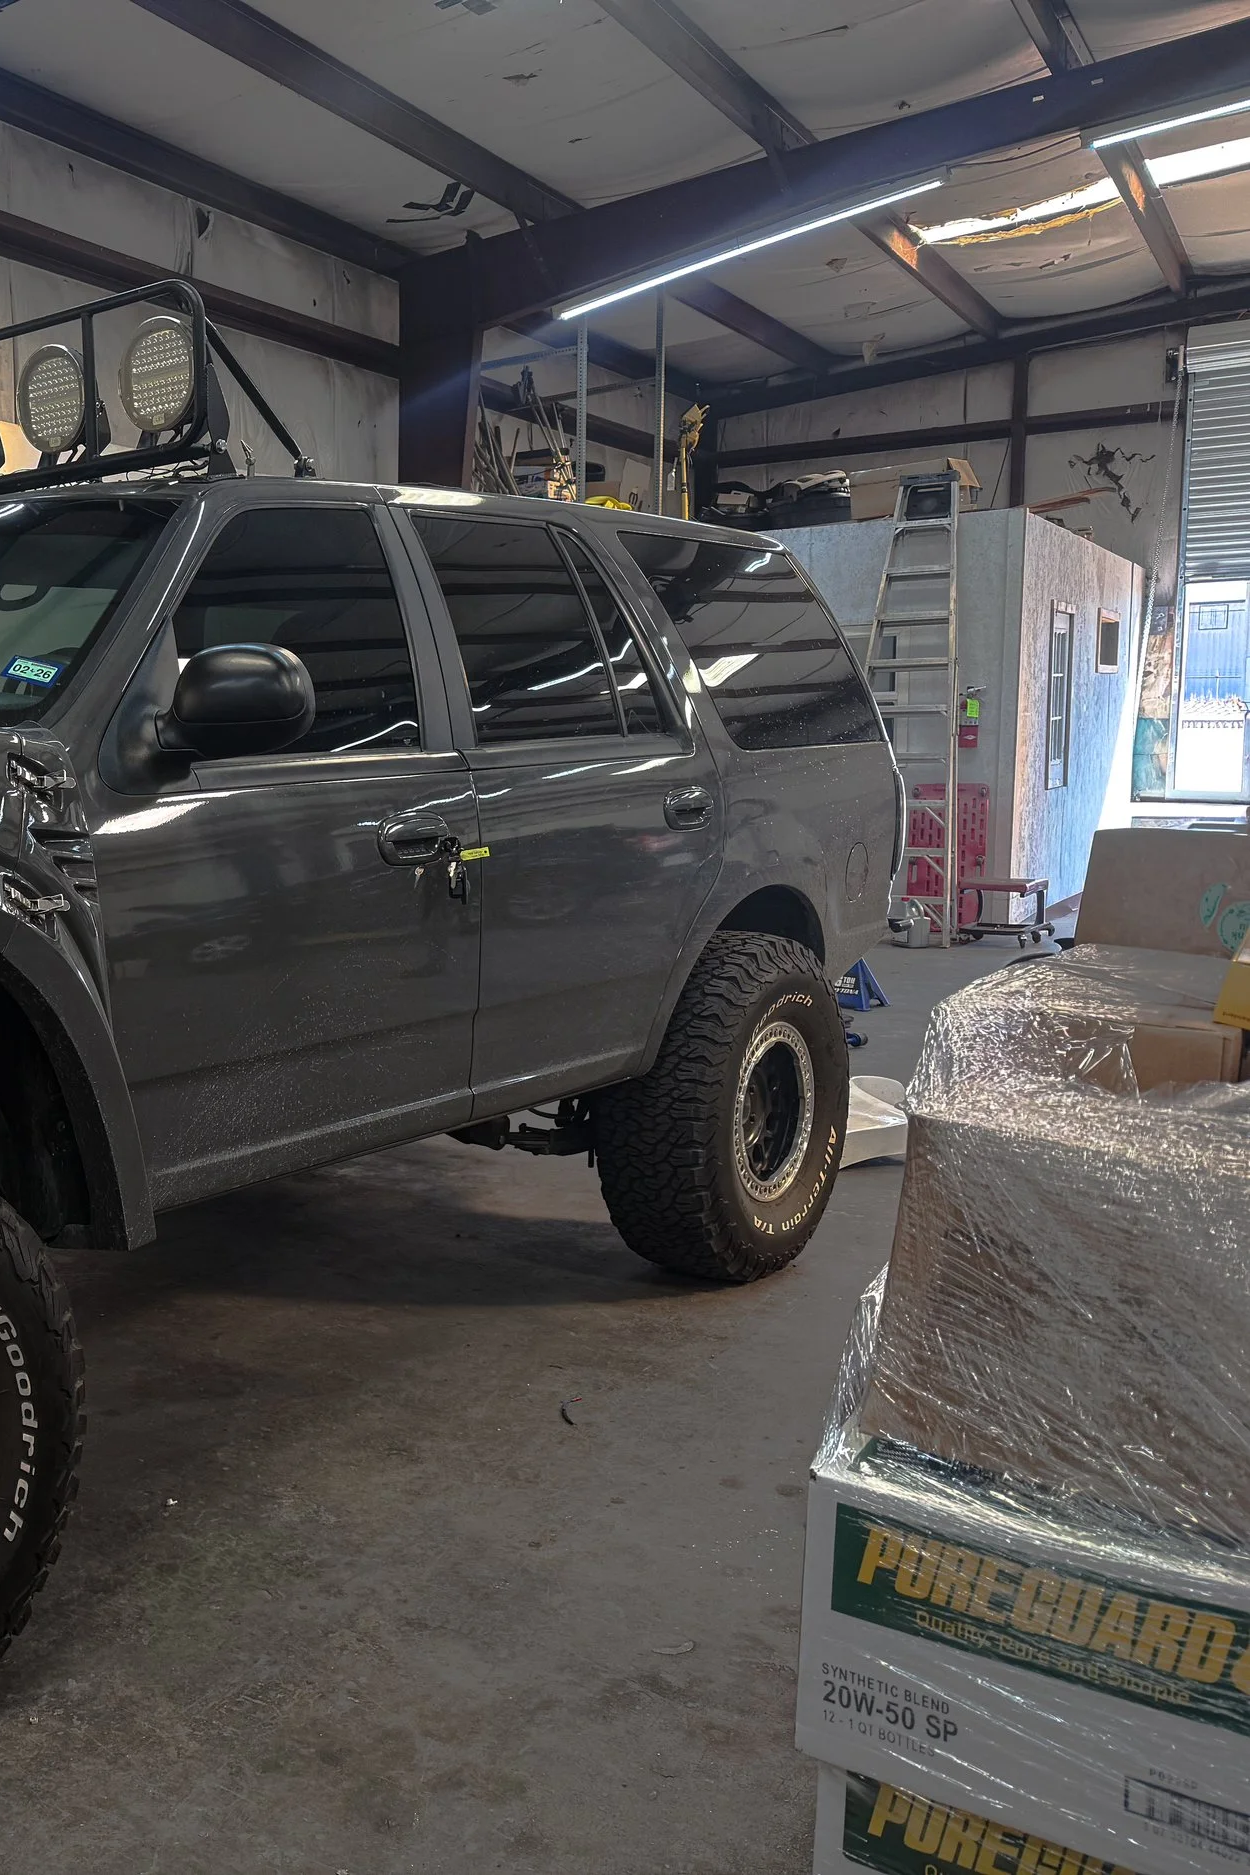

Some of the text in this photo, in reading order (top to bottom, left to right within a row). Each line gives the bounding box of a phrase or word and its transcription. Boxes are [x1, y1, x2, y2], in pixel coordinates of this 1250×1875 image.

[12, 663, 31, 675] 02
[34, 668, 52, 679] 26
[781, 1125, 837, 1232] All-Terrain
[857, 1520, 1236, 1684] PUREGUARD
[821, 1662, 950, 1715] SYNTHETIC BLEND
[822, 1680, 959, 1742] 20W-50 SP
[823, 1709, 836, 1724] 12
[858, 1721, 874, 1737] QT
[878, 1728, 936, 1758] BOTTLES
